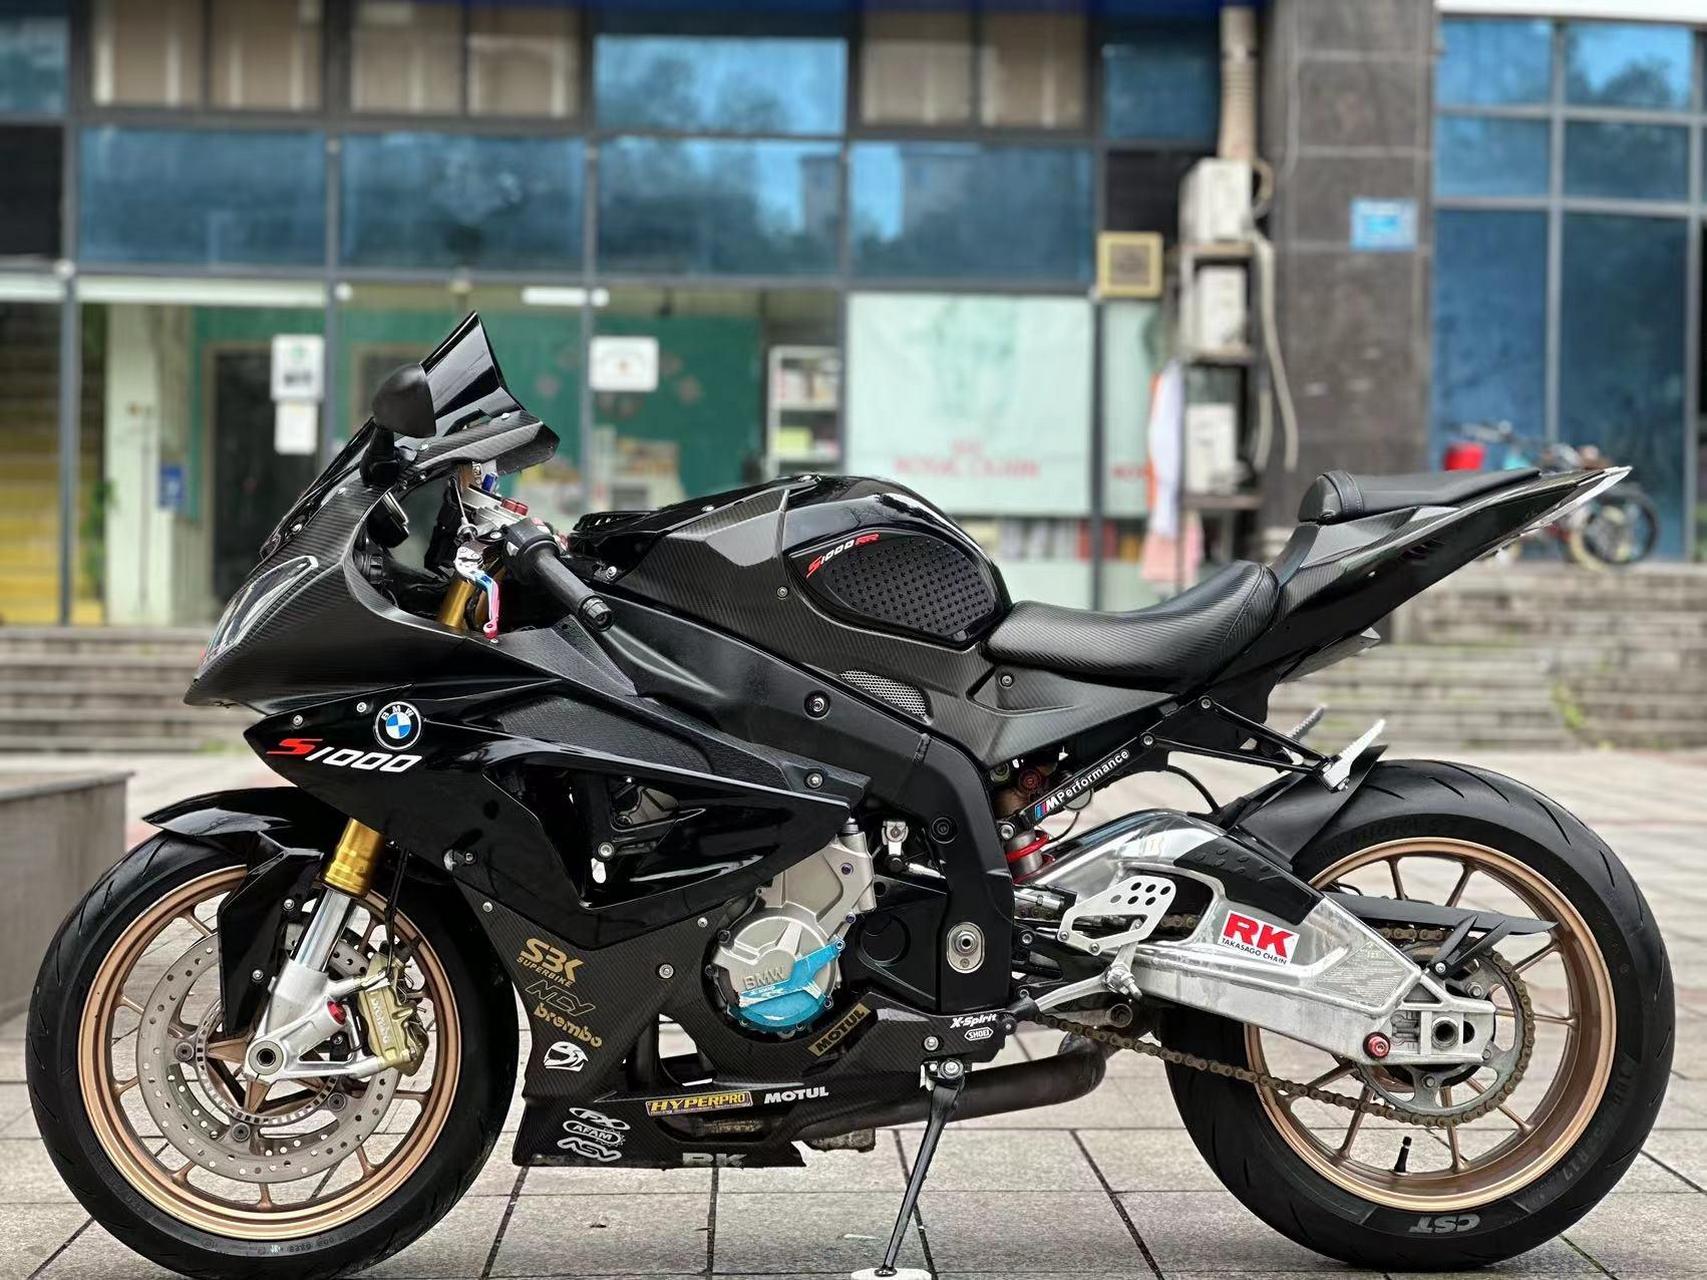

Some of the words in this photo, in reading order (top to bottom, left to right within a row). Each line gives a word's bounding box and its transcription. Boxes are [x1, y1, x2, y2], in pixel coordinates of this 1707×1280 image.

[380, 704, 415, 721] BMW
[266, 738, 423, 773] S1000
[1223, 912, 1294, 959] RK
[519, 937, 584, 983] SBK
[1221, 937, 1262, 957] TAKASAGO
[1262, 951, 1287, 965] CHAIN
[516, 956, 574, 988] SUPERBIKE
[742, 966, 786, 991] BMW
[533, 1002, 603, 1048] brembo
[815, 1008, 867, 1053] MOTUL
[949, 1013, 998, 1029] X-Spirit
[968, 1029, 991, 1040] SHOEI
[651, 1093, 747, 1112] HYPERPRO
[763, 1086, 830, 1105] MOTUL
[572, 1124, 613, 1141] AFAM
[1408, 1213, 1481, 1234] CST
